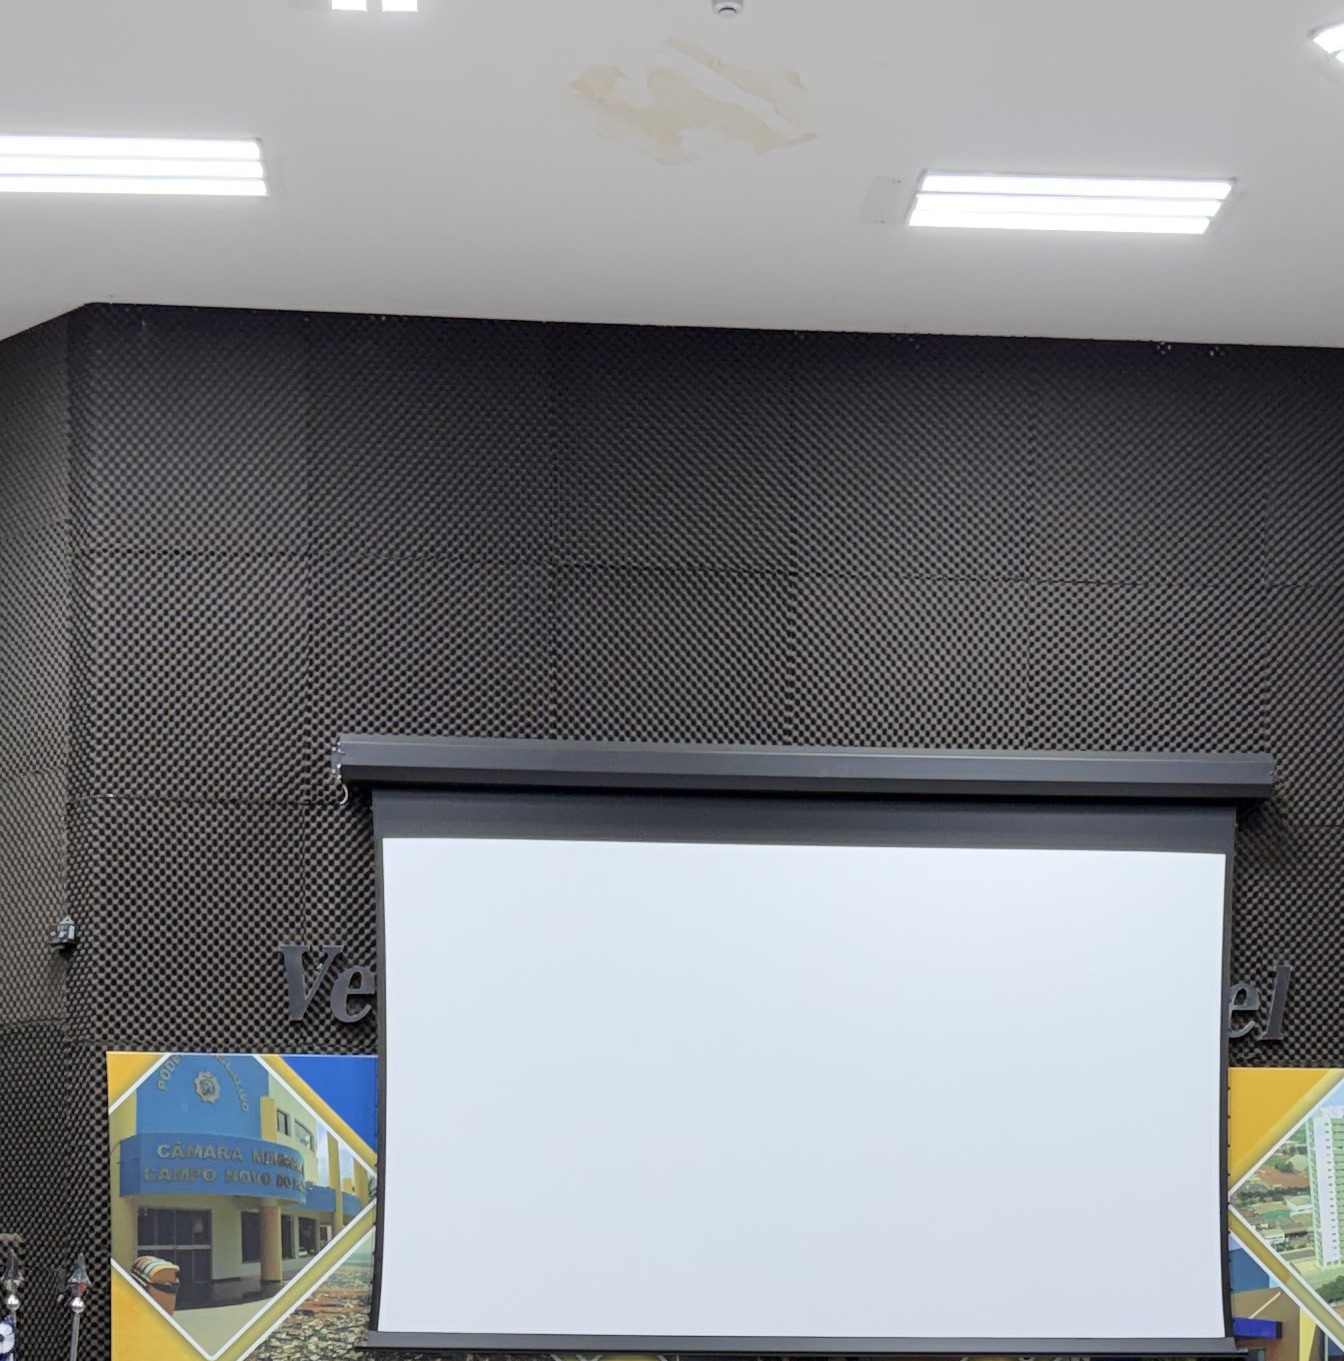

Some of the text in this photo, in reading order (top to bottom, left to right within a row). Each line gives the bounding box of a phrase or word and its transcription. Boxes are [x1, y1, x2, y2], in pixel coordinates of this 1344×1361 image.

[156, 1142, 244, 1162] CÂMARA
[143, 1167, 218, 1184] CAMPO
[225, 1169, 272, 1186] NOVO
